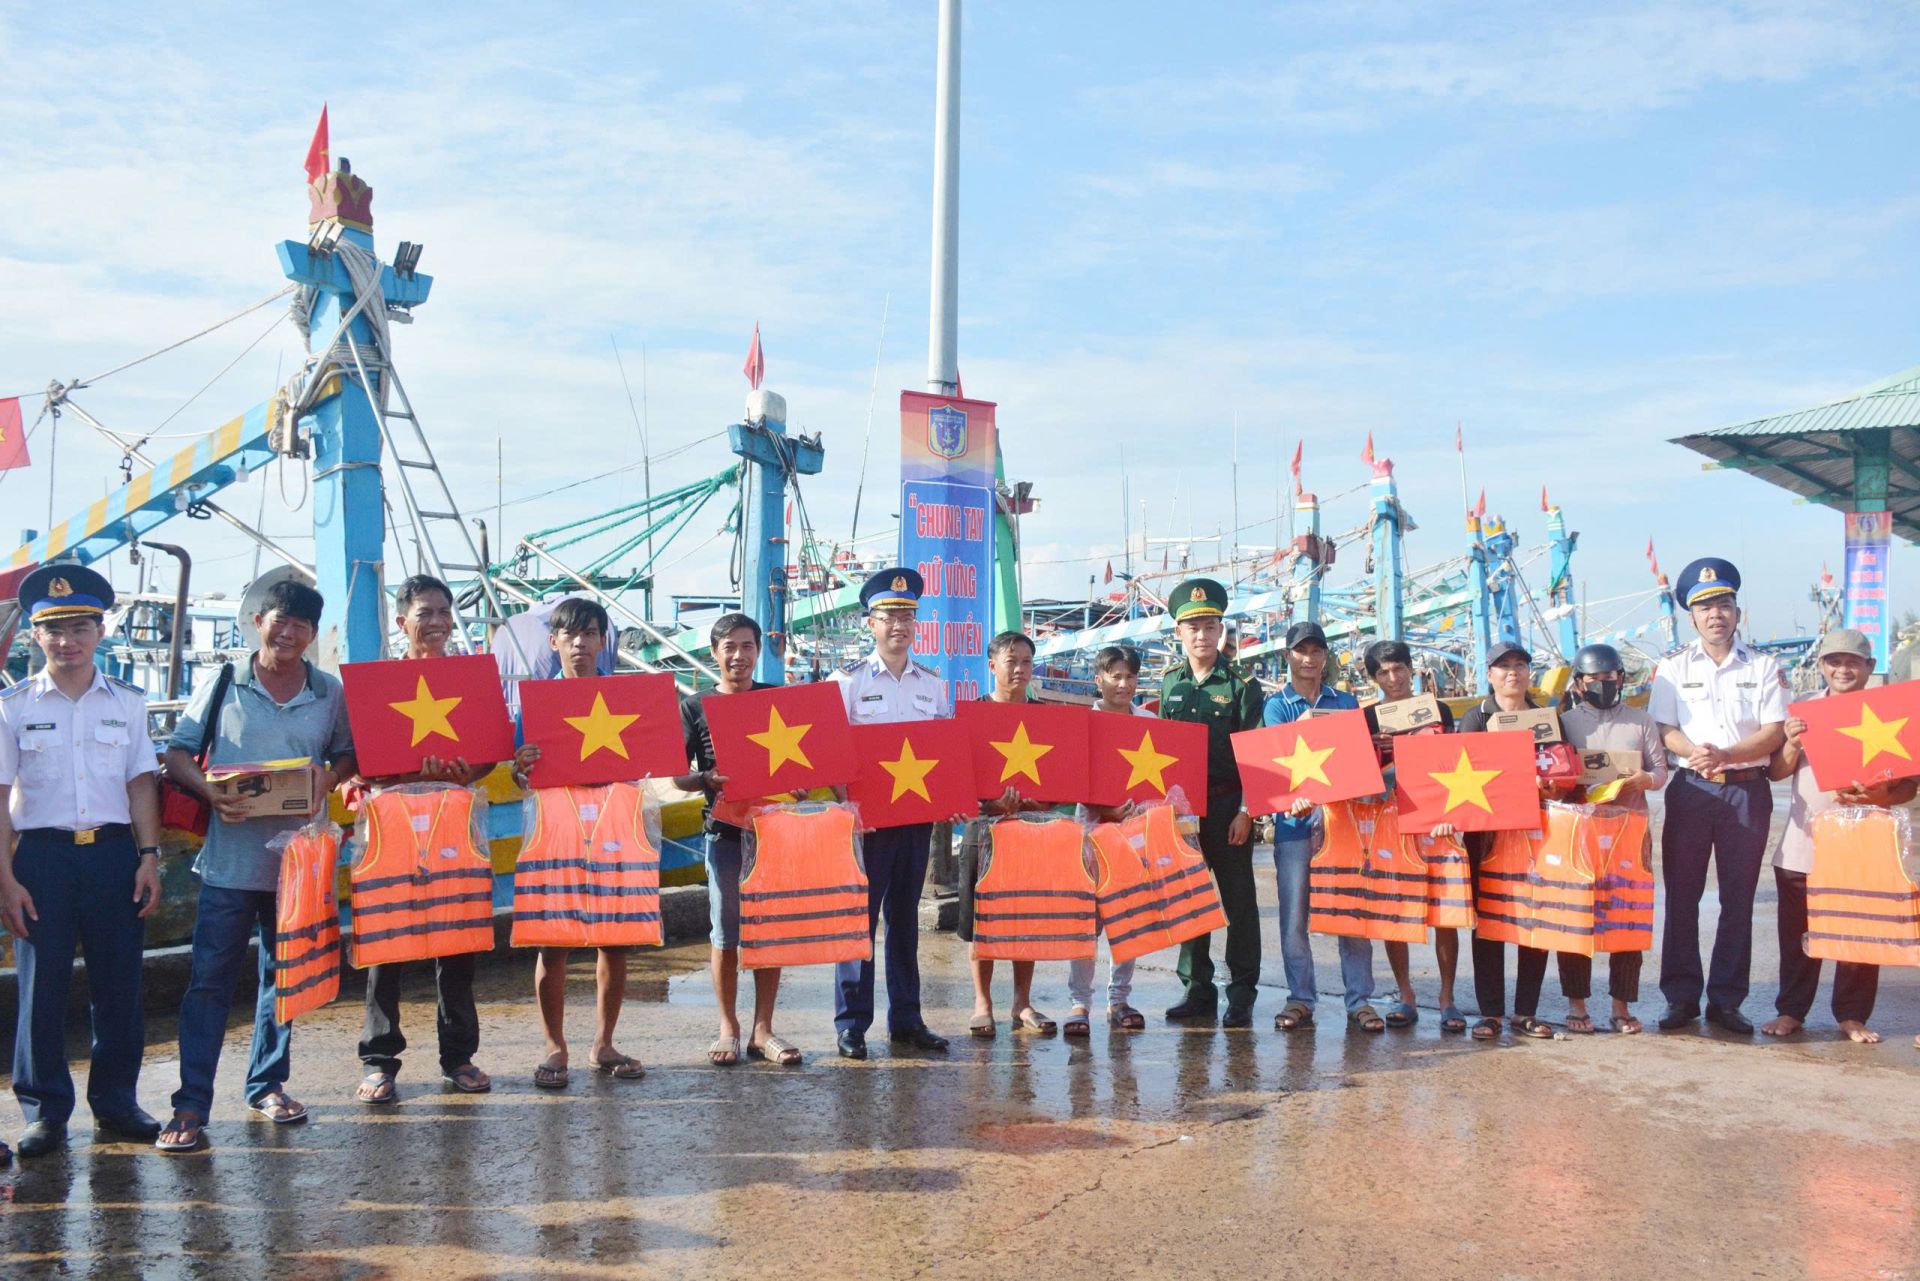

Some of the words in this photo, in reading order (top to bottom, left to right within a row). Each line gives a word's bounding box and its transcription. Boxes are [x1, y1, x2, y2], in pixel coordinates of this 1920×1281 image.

[964, 507, 984, 541] TAY
[912, 608, 940, 656] CHỦ
[943, 611, 982, 660] QUYỀN
